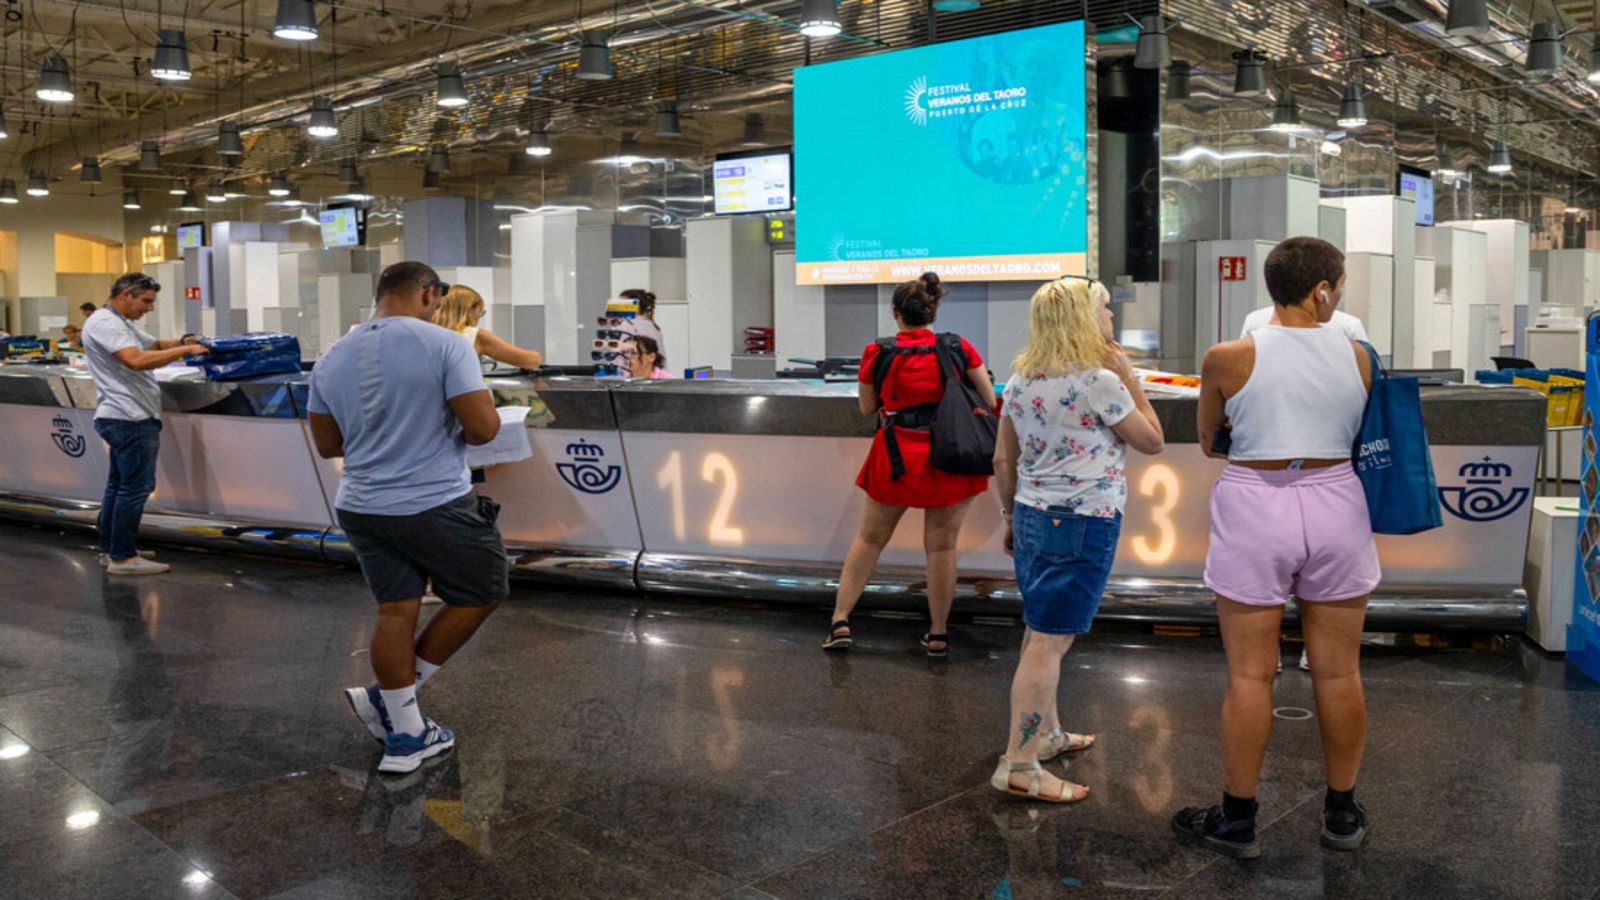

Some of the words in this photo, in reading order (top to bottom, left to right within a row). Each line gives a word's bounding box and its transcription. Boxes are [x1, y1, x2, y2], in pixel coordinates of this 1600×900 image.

[928, 83, 971, 96] FESTIVAL
[928, 94, 972, 108] VERANOS
[973, 91, 992, 103] DEL
[993, 87, 1027, 100] TAORO
[929, 107, 966, 118] PUERTO
[969, 104, 982, 113] DE
[985, 102, 997, 112] LA
[1000, 99, 1027, 109] CRUZ
[845, 239, 882, 249] FESTIVAL
[845, 248, 883, 259] VERANOS
[884, 248, 899, 258] DEL
[901, 247, 930, 257] TAORO
[657, 450, 744, 546] 12
[1131, 463, 1180, 565] 3
